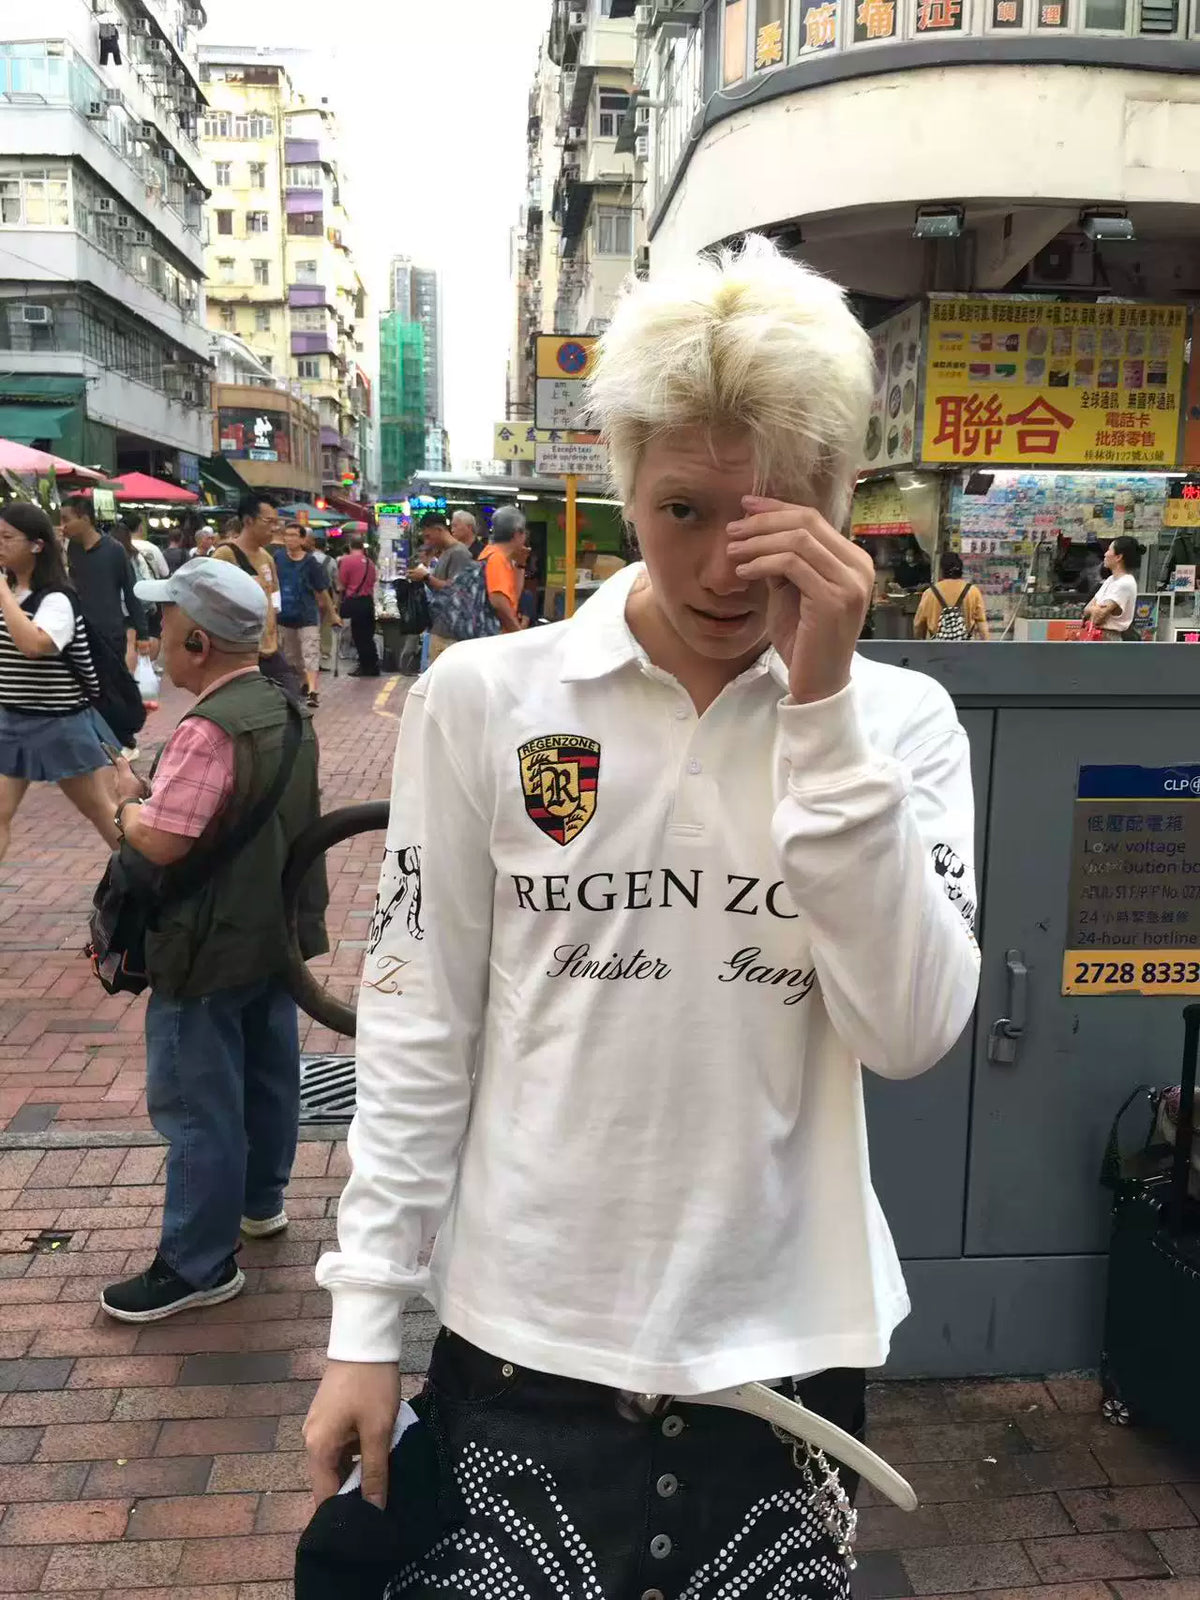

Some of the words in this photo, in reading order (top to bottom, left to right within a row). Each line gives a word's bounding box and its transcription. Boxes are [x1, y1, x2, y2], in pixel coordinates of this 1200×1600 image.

[933, 393, 1075, 457] 聯合
[1105, 411, 1150, 428] 電話卡
[1095, 430, 1156, 447] 批發零售
[522, 737, 596, 755] REGENZONE
[1164, 779, 1189, 791] CLP
[1125, 839, 1186, 856] voltage
[511, 868, 703, 912] REGEN
[1077, 932, 1136, 945] 24-hour
[547, 943, 672, 981] Sinister
[1075, 962, 1134, 983] 2728
[1142, 962, 1200, 983] 8333
